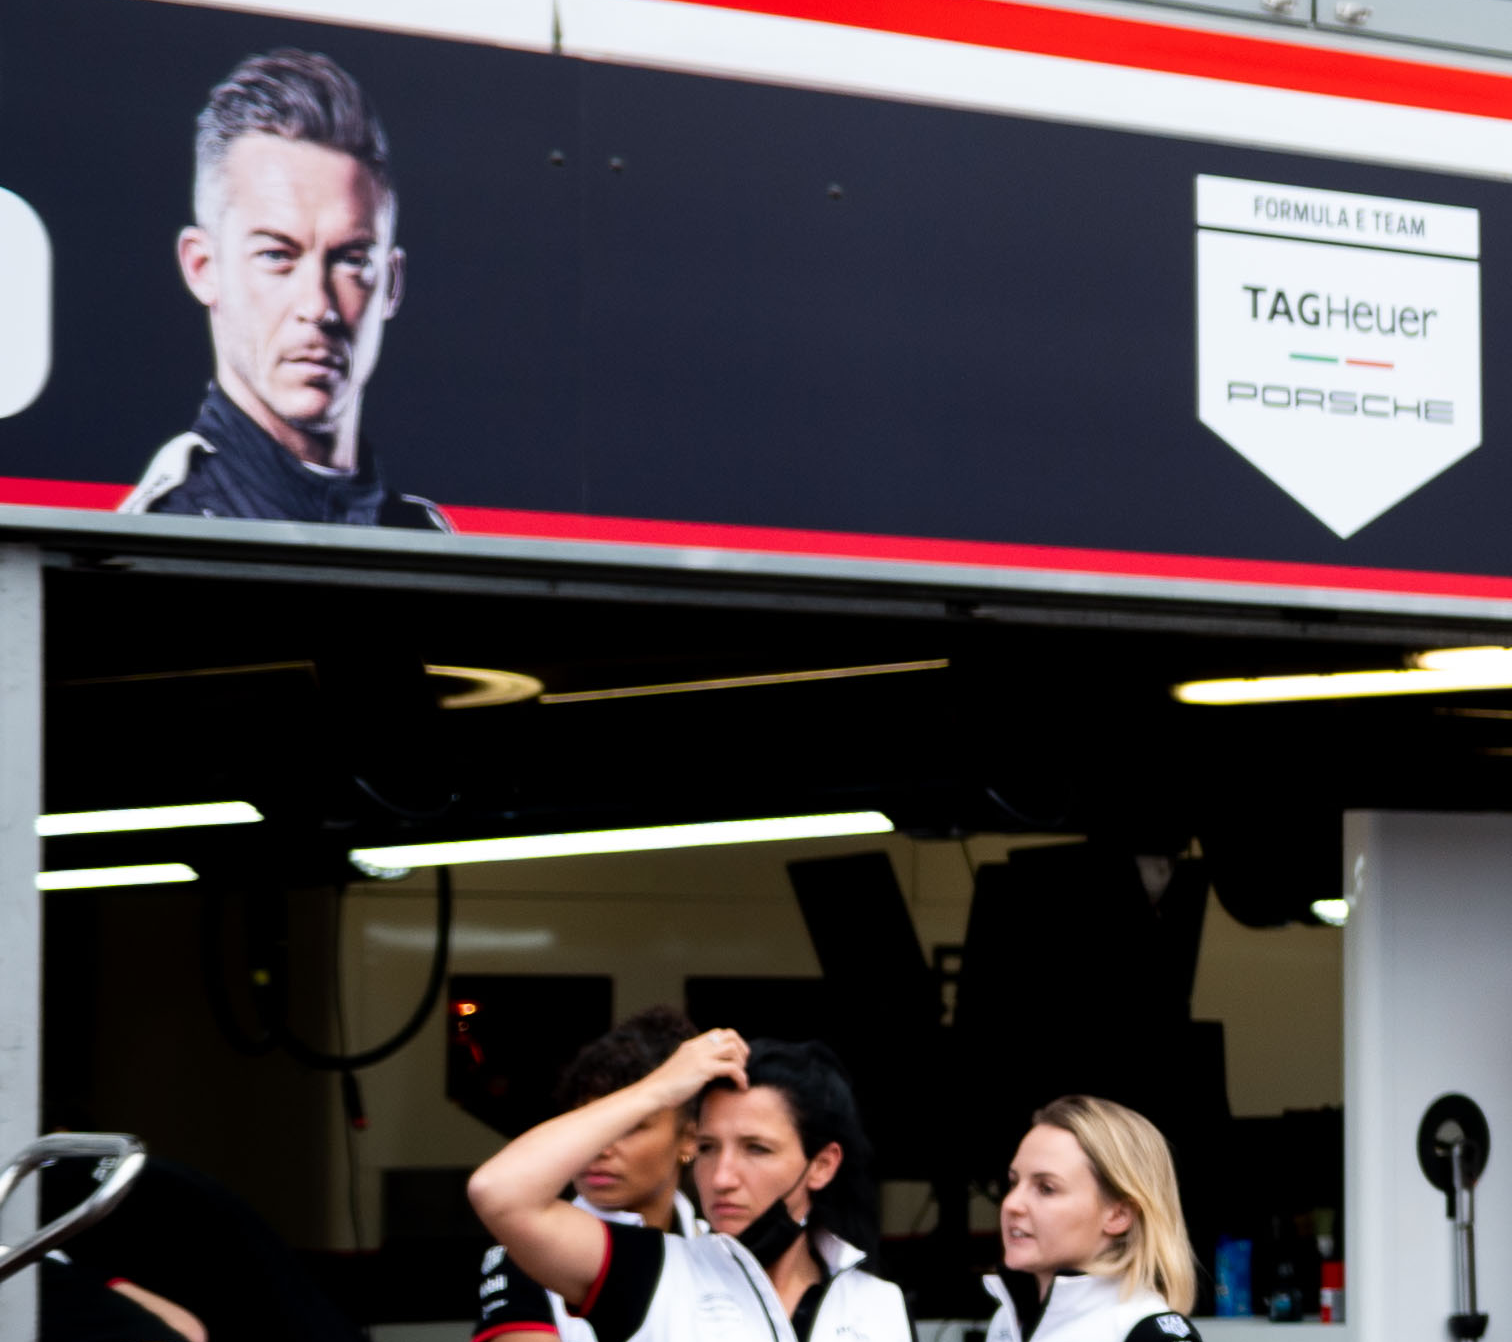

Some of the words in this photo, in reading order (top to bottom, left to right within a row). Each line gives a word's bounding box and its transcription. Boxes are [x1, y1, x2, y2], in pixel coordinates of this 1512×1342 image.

[1253, 196, 1349, 228] FORMULA
[1356, 207, 1367, 230] E
[1374, 211, 1427, 236] TEAM
[1228, 381, 1453, 425] PORSCHE
